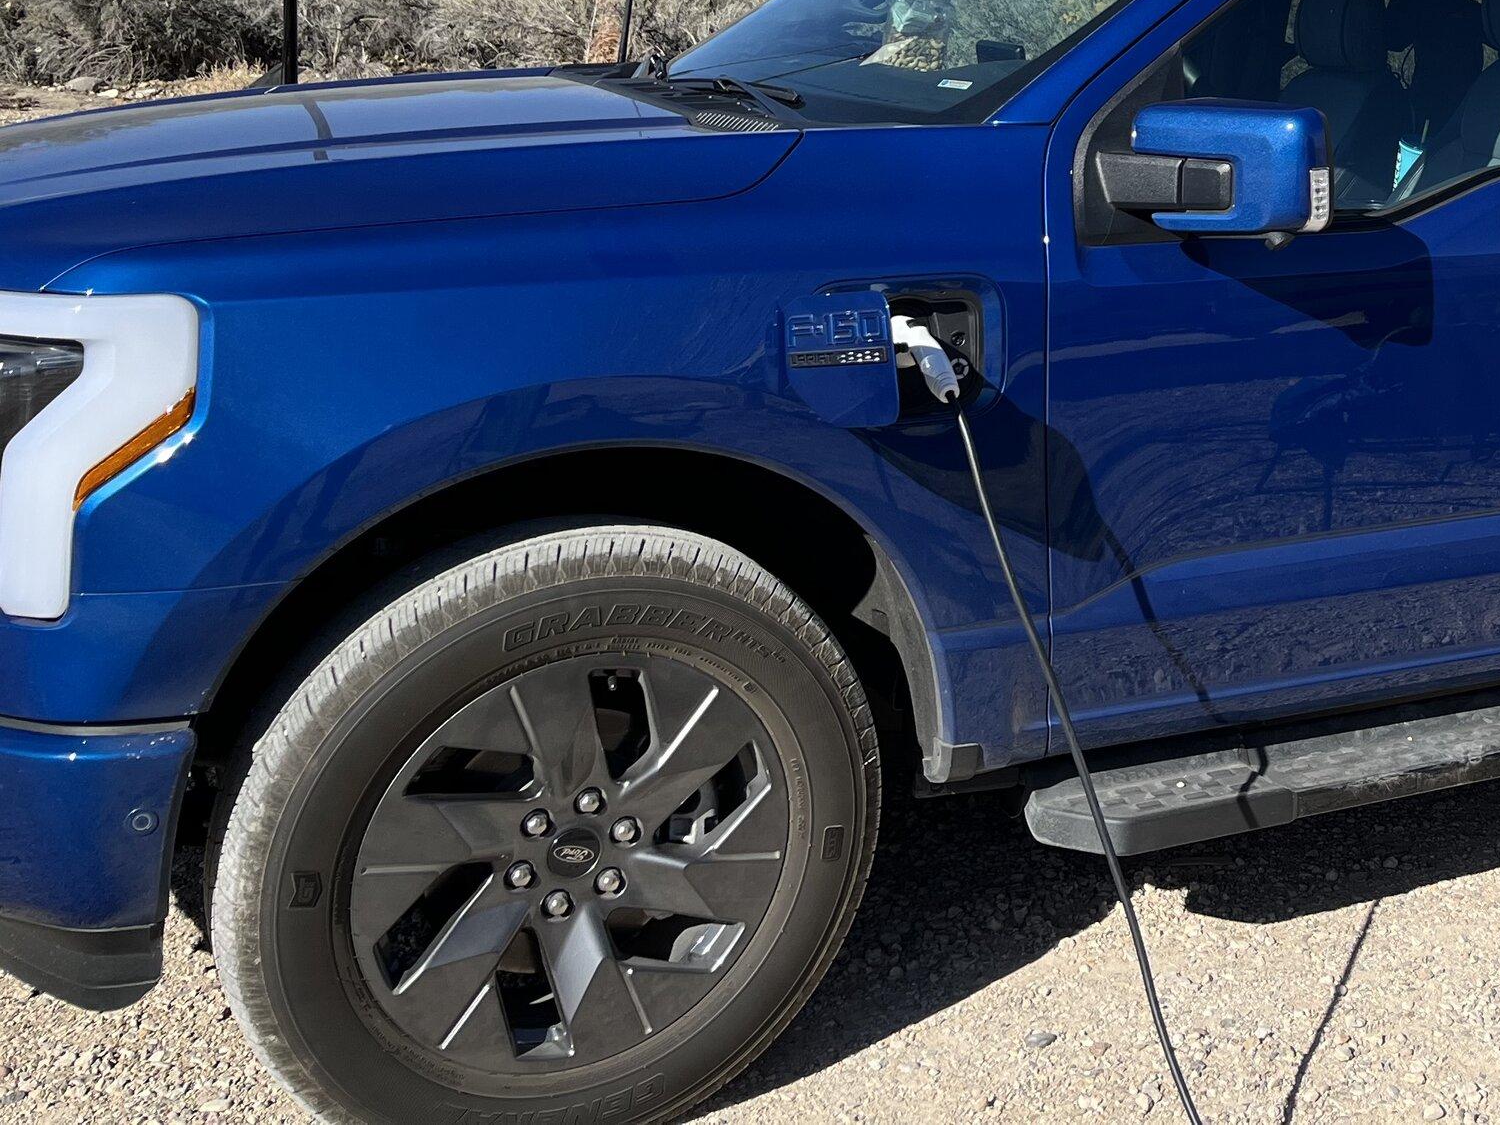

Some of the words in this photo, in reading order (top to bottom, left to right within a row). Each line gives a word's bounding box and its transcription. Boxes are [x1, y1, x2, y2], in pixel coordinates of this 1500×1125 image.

[785, 309, 888, 348] F-150
[502, 603, 734, 653] GRABBER
[559, 847, 589, 862] Ford
